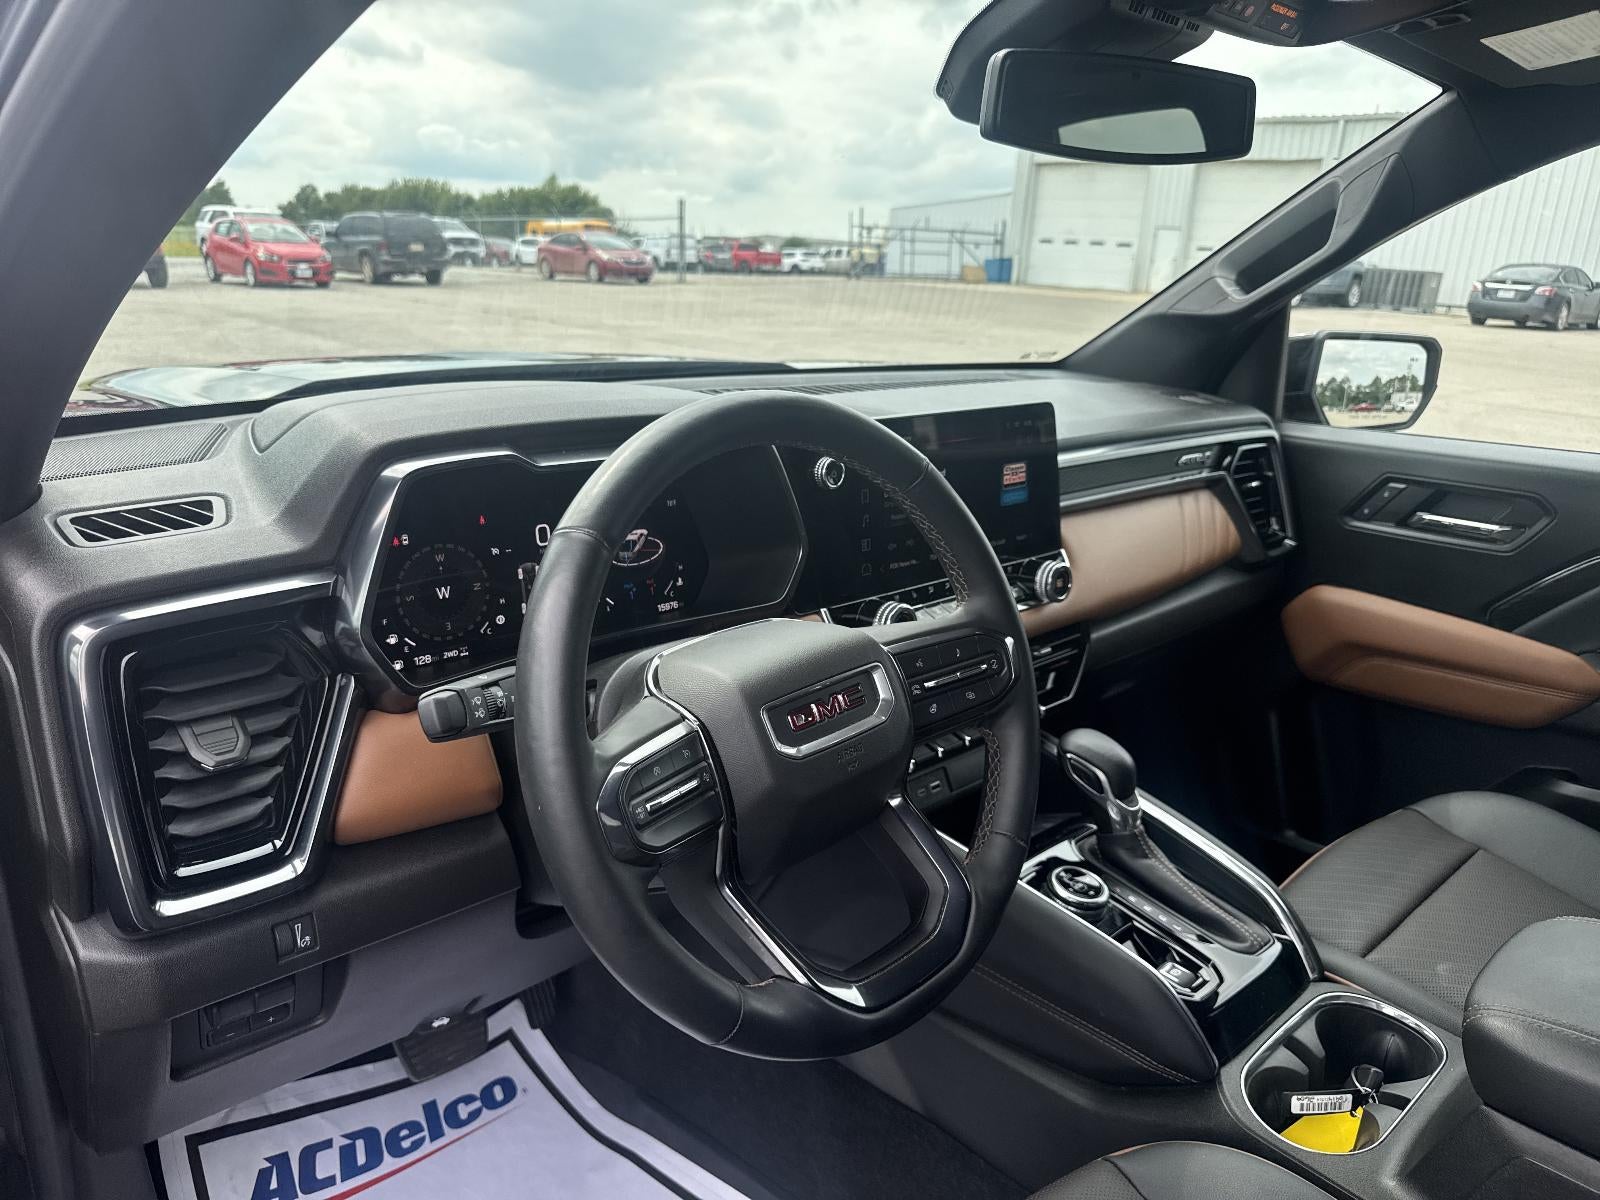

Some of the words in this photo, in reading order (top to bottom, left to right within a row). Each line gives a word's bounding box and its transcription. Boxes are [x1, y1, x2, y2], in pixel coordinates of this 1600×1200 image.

[434, 585, 451, 600] W
[657, 600, 679, 613] 15976
[413, 654, 432, 666] 128
[443, 649, 459, 659] 2WD
[787, 684, 867, 732] GMC
[250, 1076, 518, 1200] ACDelco
